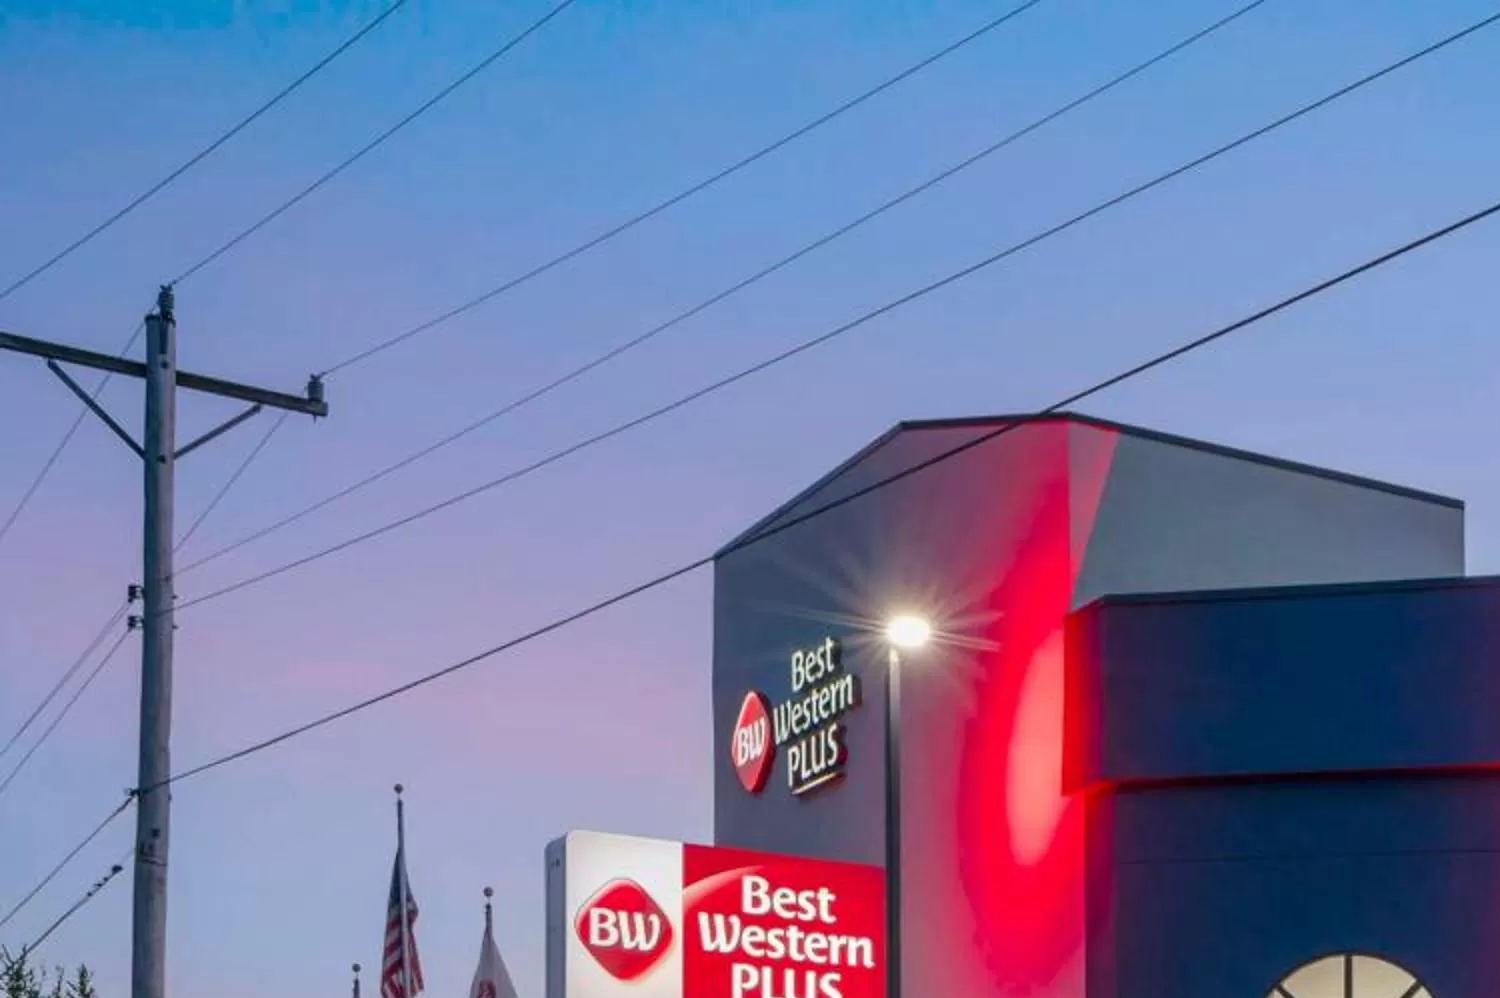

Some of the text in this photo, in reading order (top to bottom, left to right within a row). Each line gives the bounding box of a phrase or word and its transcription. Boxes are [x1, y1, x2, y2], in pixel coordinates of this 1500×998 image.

[791, 635, 835, 693] Best
[773, 673, 853, 745] Western
[736, 716, 766, 768] BW
[787, 722, 838, 788] PLUS
[741, 875, 837, 924] Best
[588, 907, 661, 952] BW
[698, 911, 875, 968] Western
